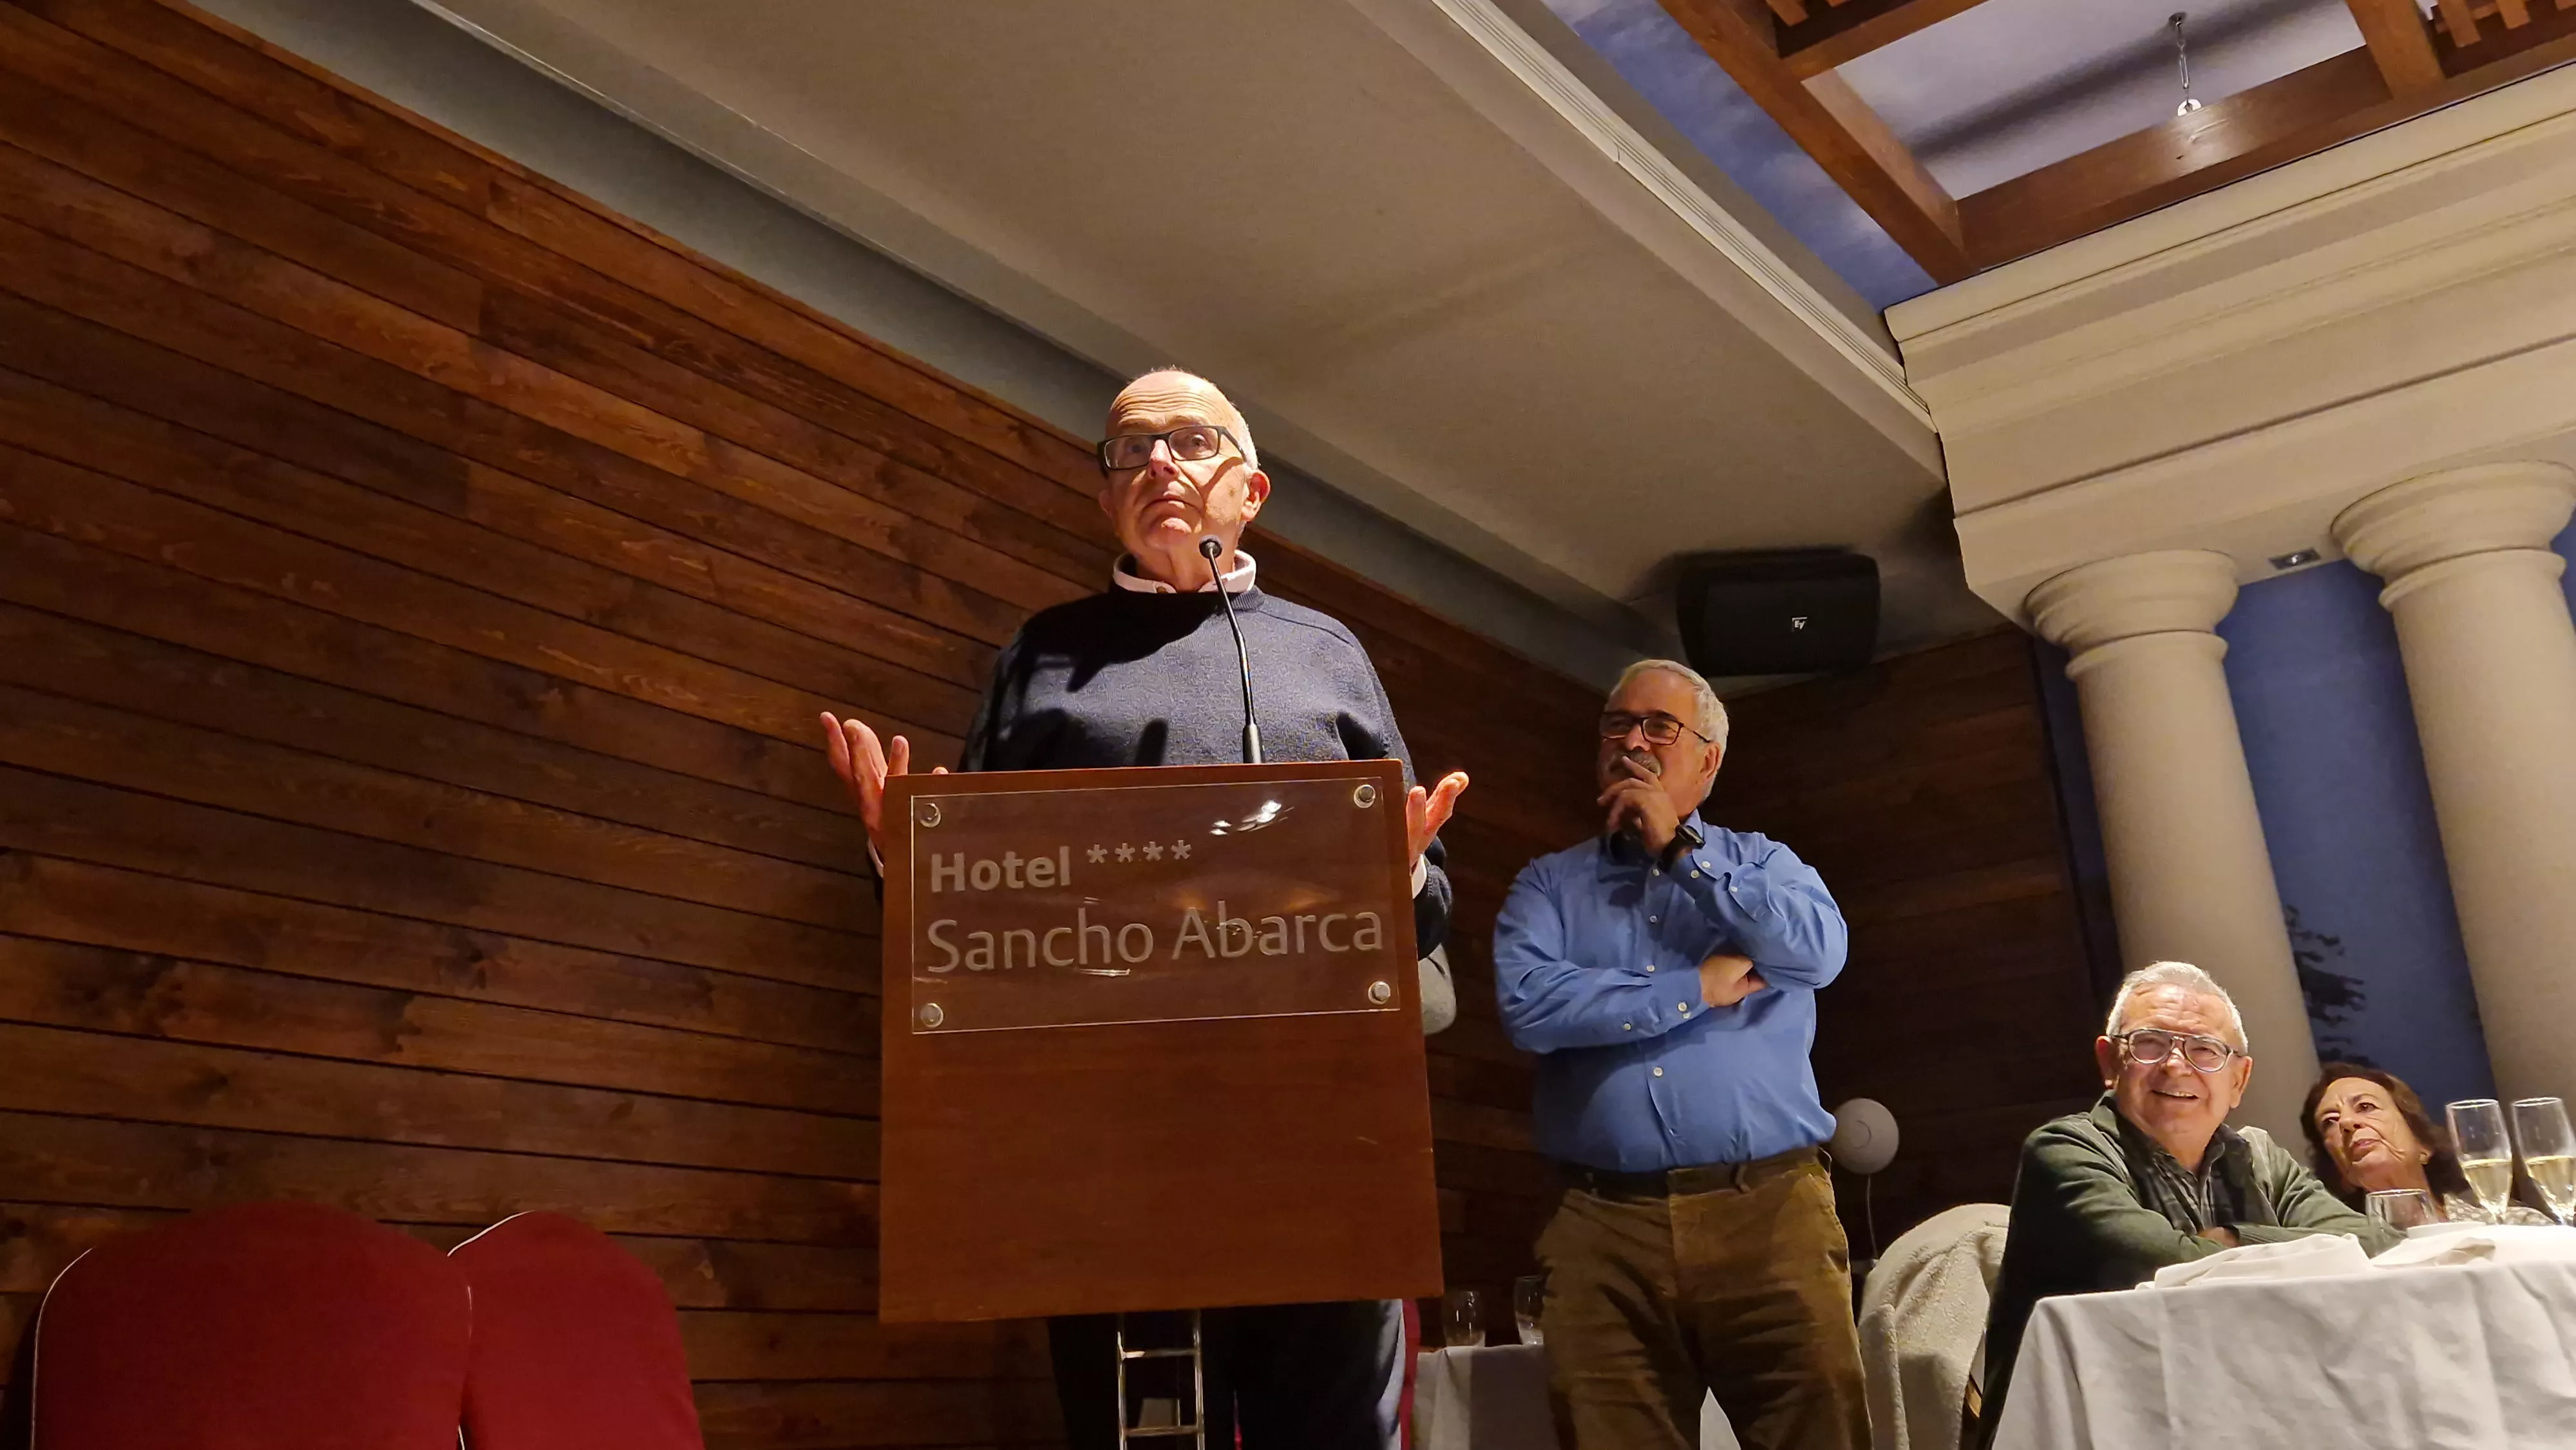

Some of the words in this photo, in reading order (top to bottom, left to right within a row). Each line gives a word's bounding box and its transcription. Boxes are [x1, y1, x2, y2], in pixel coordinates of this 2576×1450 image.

[929, 846, 1071, 893] Hotel
[927, 907, 1154, 974] Sancho
[1171, 900, 1383, 960] Abarca
